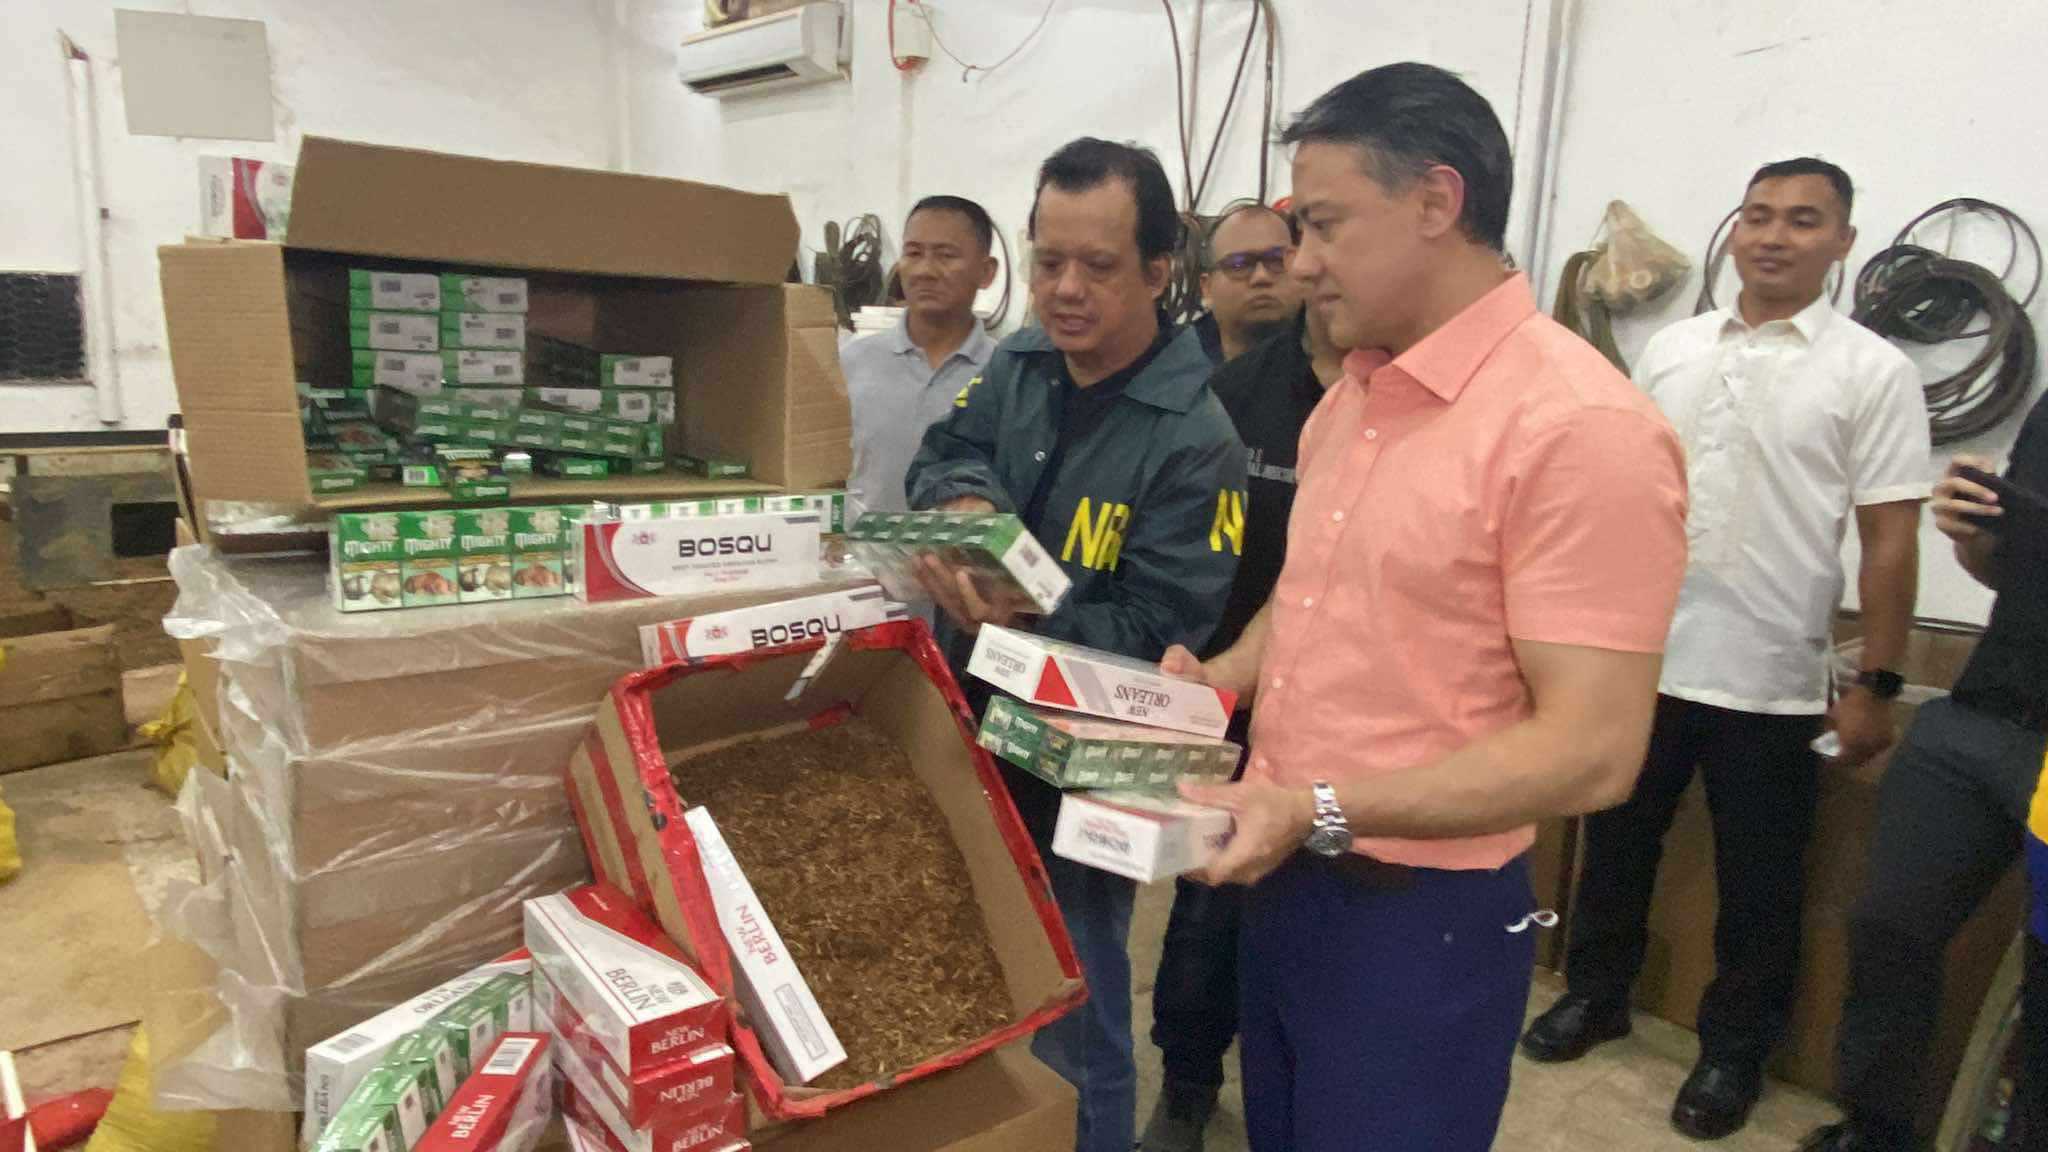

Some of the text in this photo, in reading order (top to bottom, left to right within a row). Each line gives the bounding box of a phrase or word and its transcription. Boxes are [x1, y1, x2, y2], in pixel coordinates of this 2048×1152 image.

[344, 540, 393, 558] MIGHTY
[404, 537, 451, 555] MIGHTY
[678, 534, 772, 558] BOSQU
[751, 614, 842, 649] BOSQU
[985, 648, 1027, 674] ORLEANS
[1114, 683, 1171, 709] ORLEANS
[736, 904, 778, 966] BERLIN
[606, 968, 660, 1012] BERLIN
[651, 1027, 705, 1054] BERLIN
[660, 1075, 714, 1103] BERLIN
[451, 1094, 497, 1139] BERLIN
[672, 1120, 725, 1152] BERLIN
